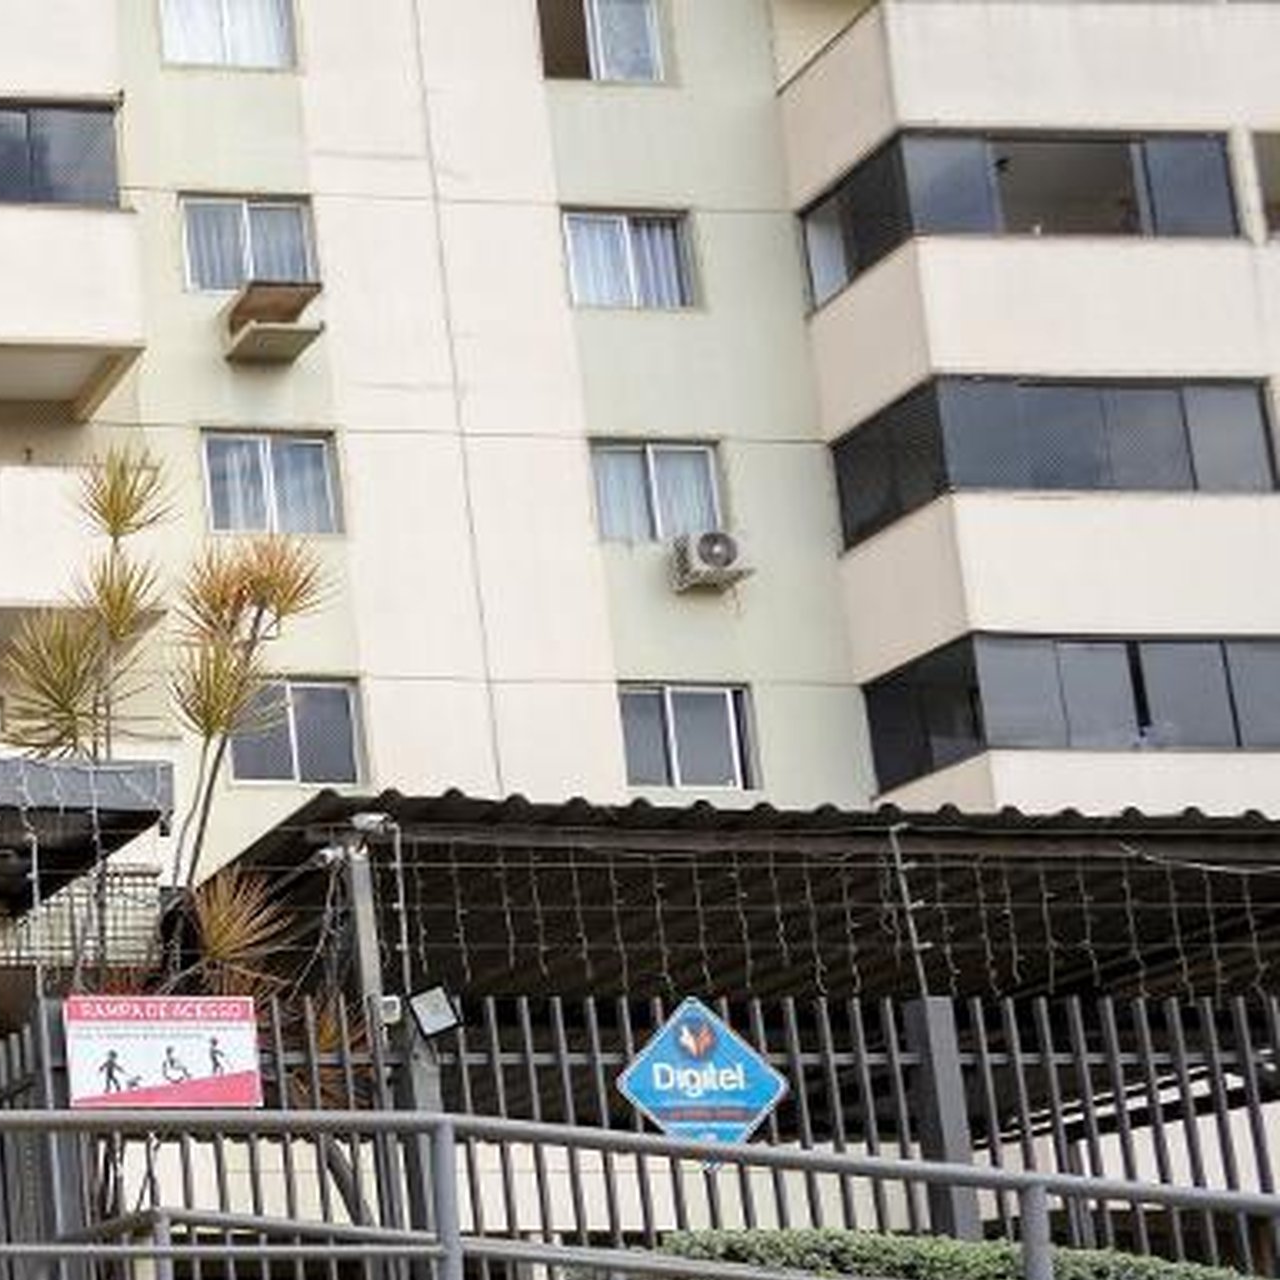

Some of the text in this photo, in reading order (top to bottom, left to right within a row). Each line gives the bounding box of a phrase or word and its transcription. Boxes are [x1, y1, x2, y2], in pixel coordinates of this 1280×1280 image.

[81, 1001, 242, 1018] RAMPA DE ACESSO
[652, 1062, 746, 1098] Digitel
